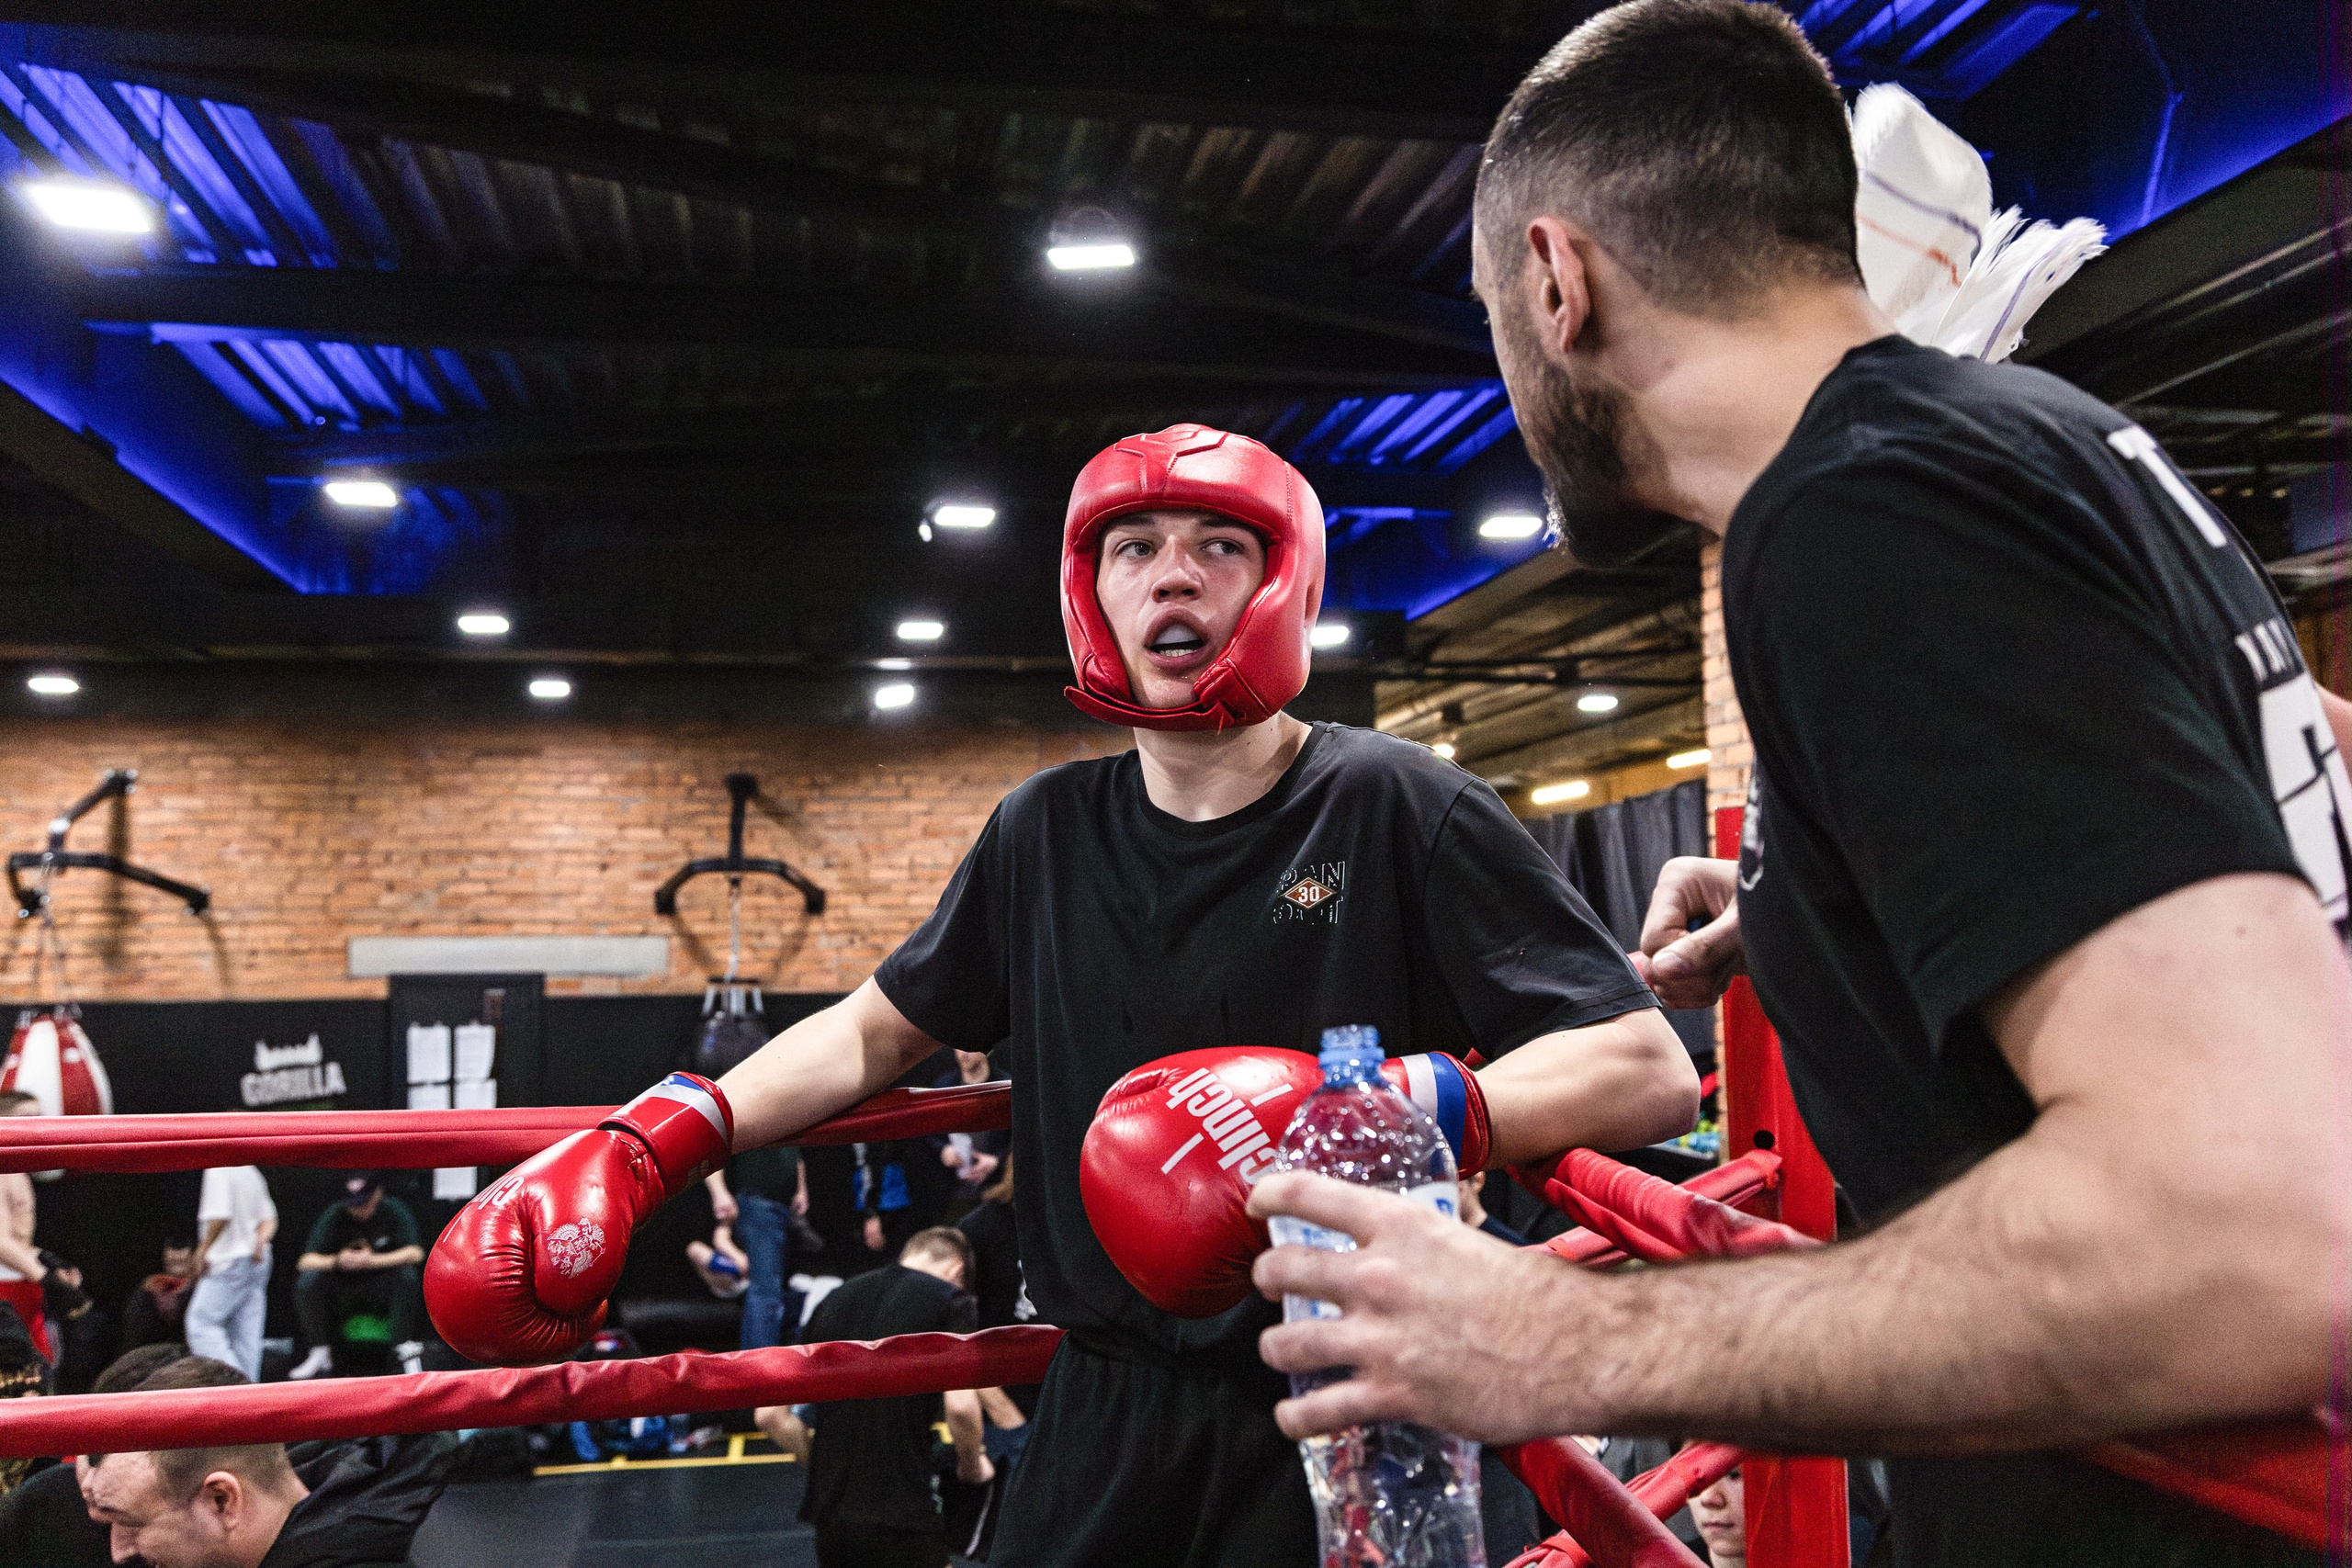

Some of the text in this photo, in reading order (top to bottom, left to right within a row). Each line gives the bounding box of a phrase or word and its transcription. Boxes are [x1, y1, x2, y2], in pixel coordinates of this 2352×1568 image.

[1297, 886, 1320, 903] 30
[240, 1061, 347, 1106] GORILLA
[1165, 1066, 1283, 1185] clinch
